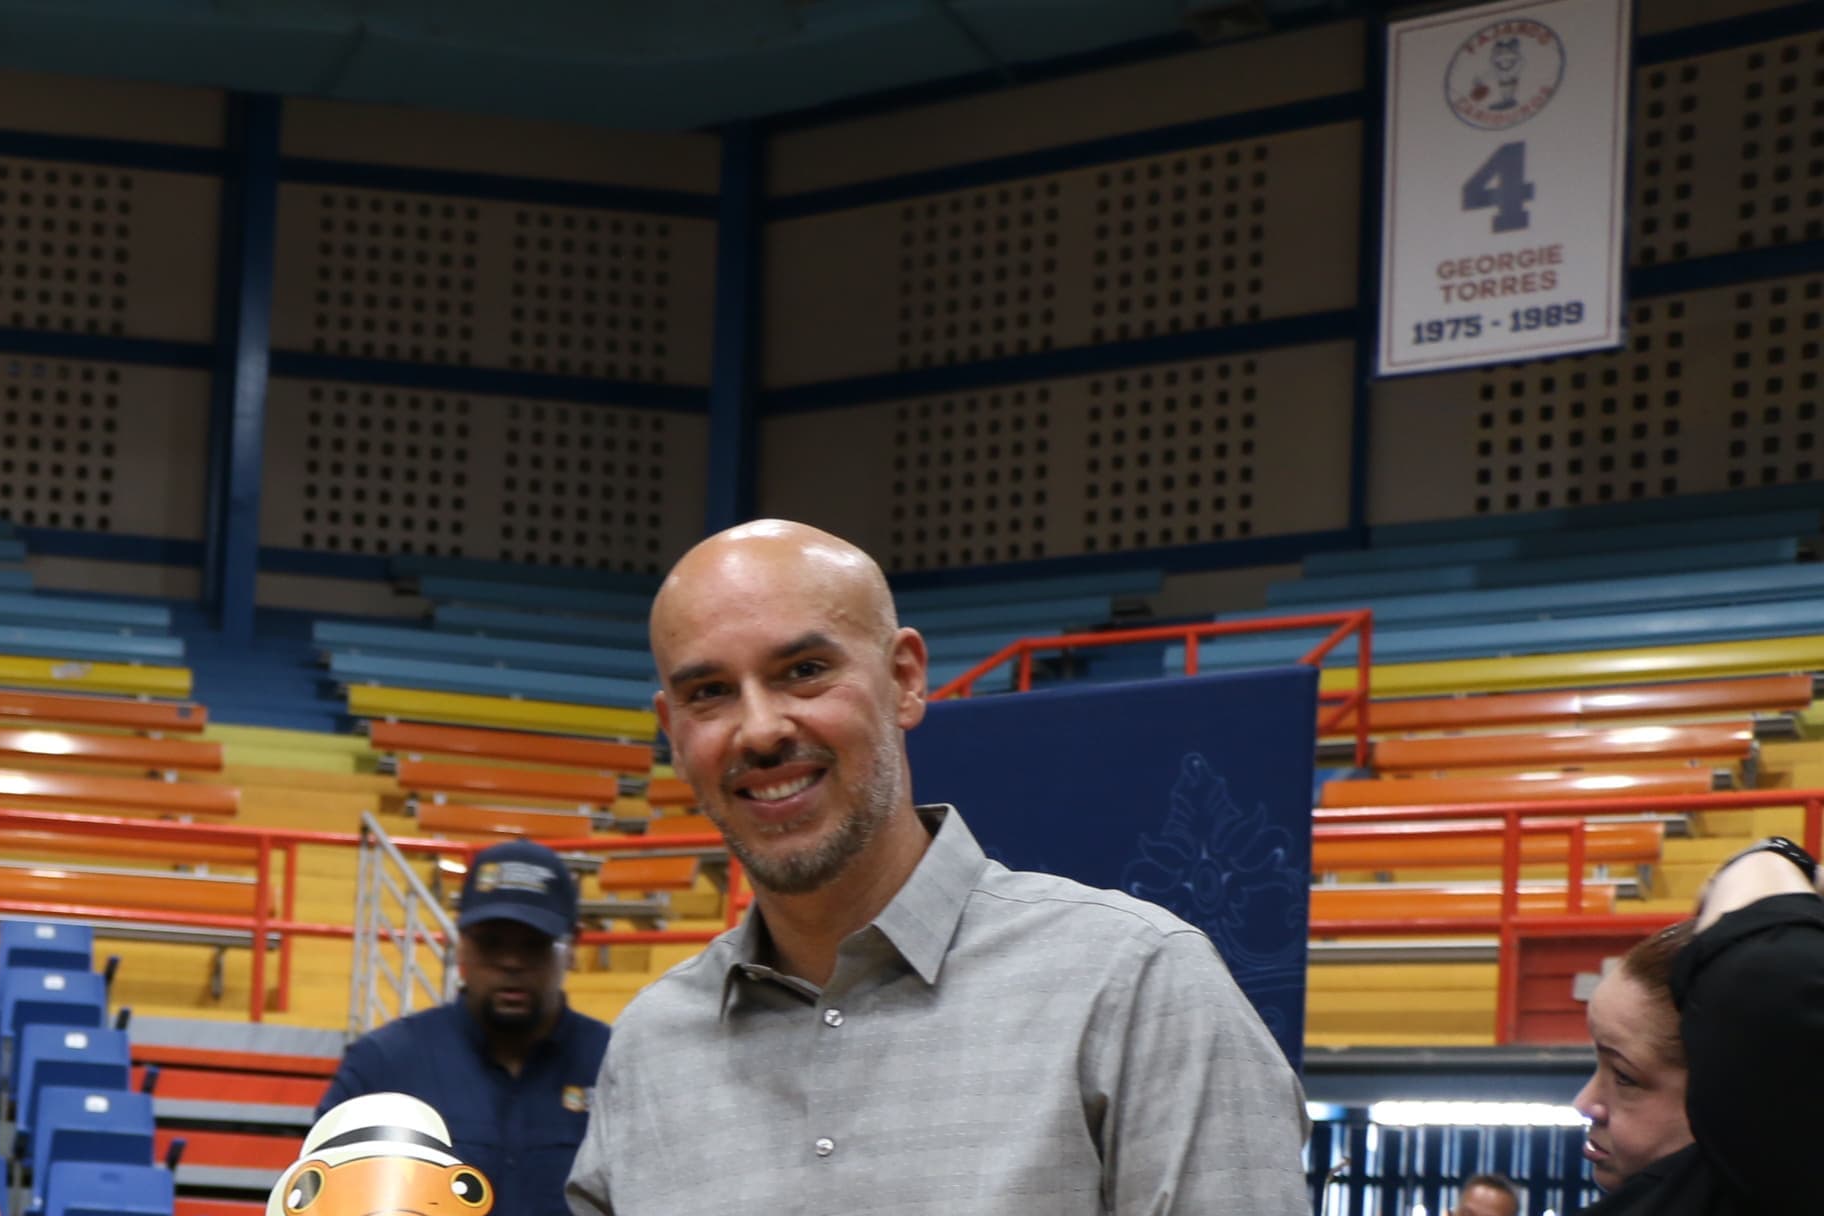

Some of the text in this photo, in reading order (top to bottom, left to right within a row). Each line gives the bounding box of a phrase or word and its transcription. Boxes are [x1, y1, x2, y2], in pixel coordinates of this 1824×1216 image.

[1461, 141, 1535, 234] 4
[1436, 243, 1564, 280] GEORGIE
[1439, 269, 1558, 304] TORRES
[1412, 314, 1483, 345] 1975
[1509, 301, 1585, 333] 1989
